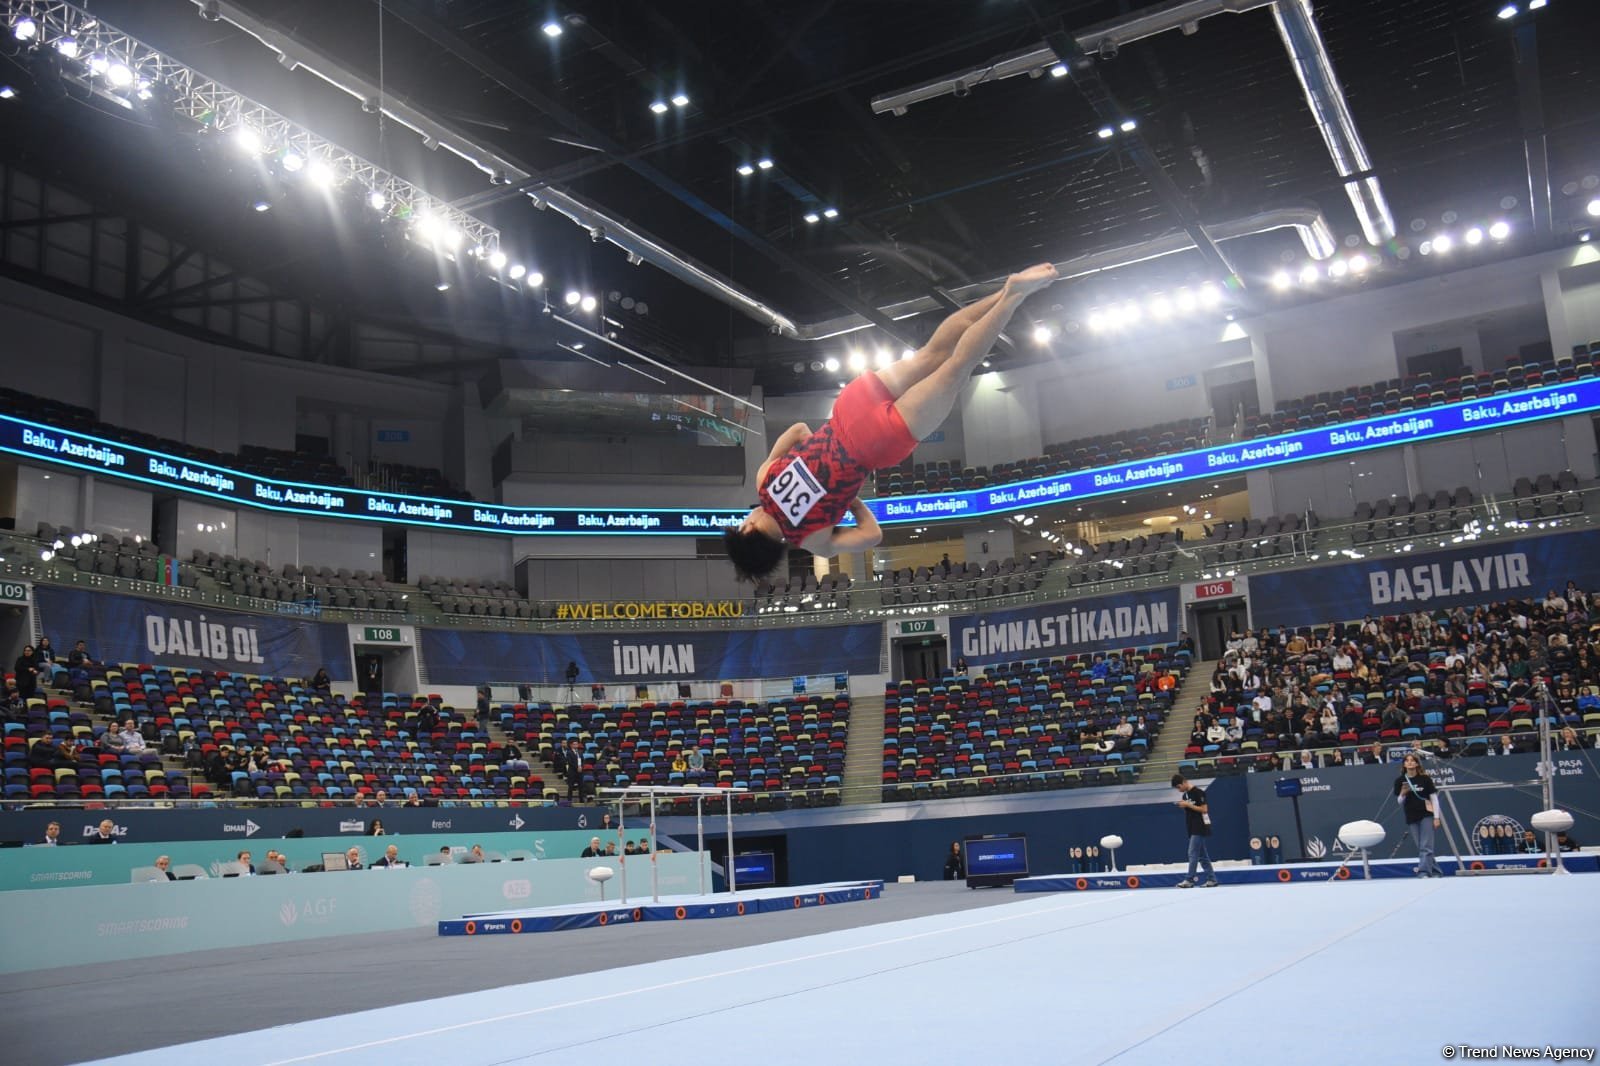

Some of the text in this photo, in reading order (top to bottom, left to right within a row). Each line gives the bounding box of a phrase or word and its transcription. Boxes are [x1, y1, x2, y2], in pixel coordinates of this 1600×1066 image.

[1462, 392, 1577, 422] Baku, Azerbaijan
[1330, 418, 1433, 446] Baku, Azerbaijan
[23, 429, 124, 466] Baku, Azerbaijan
[1208, 440, 1302, 467] Baku, Azerbaijan
[149, 458, 235, 492] Baku, Azerbaijan
[1094, 462, 1183, 487] Baku, Azerbaijan
[256, 484, 344, 509] Baku, Azerbaijan
[772, 470, 811, 517] 316
[990, 481, 1071, 505] Baku, Azerbaijan
[368, 498, 453, 520] Baku, Azerbaijan
[473, 510, 555, 529] Baku, Azerbaijan
[886, 499, 968, 516] Baku, Azerbaijan
[578, 514, 660, 529] Baku, Azerbaijan
[682, 515, 750, 528] Baku, Azerba
[1203, 584, 1224, 596] 106
[1368, 553, 1531, 605] BAŞLAYIR
[556, 602, 743, 620] #WELCOMETOBAKU
[146, 614, 265, 663] QALİB OL
[373, 629, 393, 640] 108
[907, 621, 927, 632] 107
[962, 601, 1169, 657] GİMNASTİKADAN
[613, 640, 695, 675] İDMAN
[1560, 768, 1584, 776] Bank
[1301, 785, 1331, 793] surance
[432, 818, 452, 829] trend
